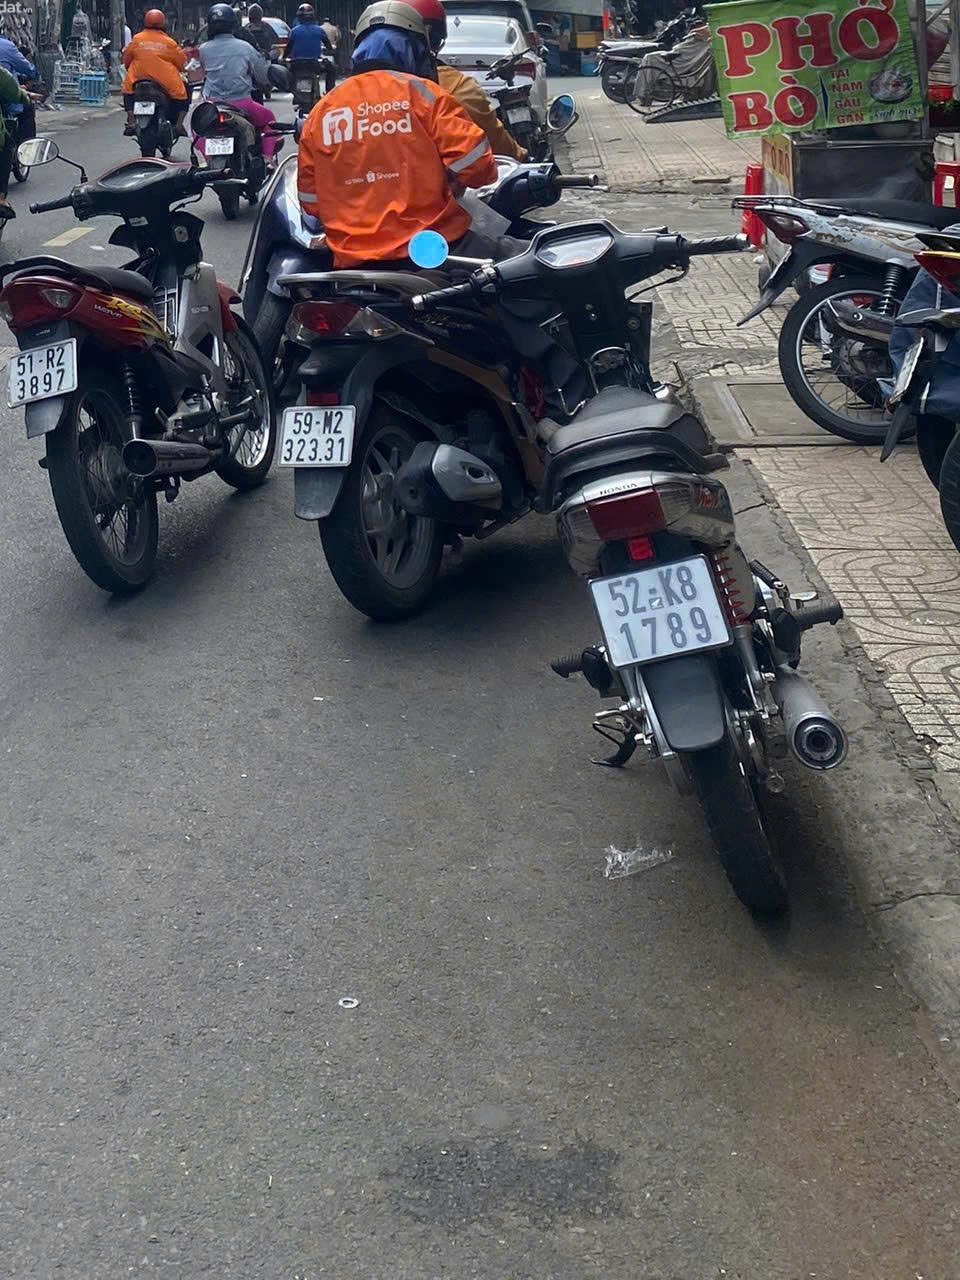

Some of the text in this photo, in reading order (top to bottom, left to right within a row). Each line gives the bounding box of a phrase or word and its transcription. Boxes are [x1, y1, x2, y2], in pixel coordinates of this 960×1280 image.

[356, 100, 410, 117] Shopee
[728, 74, 819, 132] BÒ
[357, 112, 413, 140] Food
[17, 346, 65, 376] 51-R2
[17, 368, 65, 400] 3897
[292, 410, 344, 435] 59-M2
[283, 437, 345, 462] 323.31
[599, 483, 638, 495] HONDA
[607, 565, 698, 617] 52-K8
[619, 606, 712, 659] 1789
